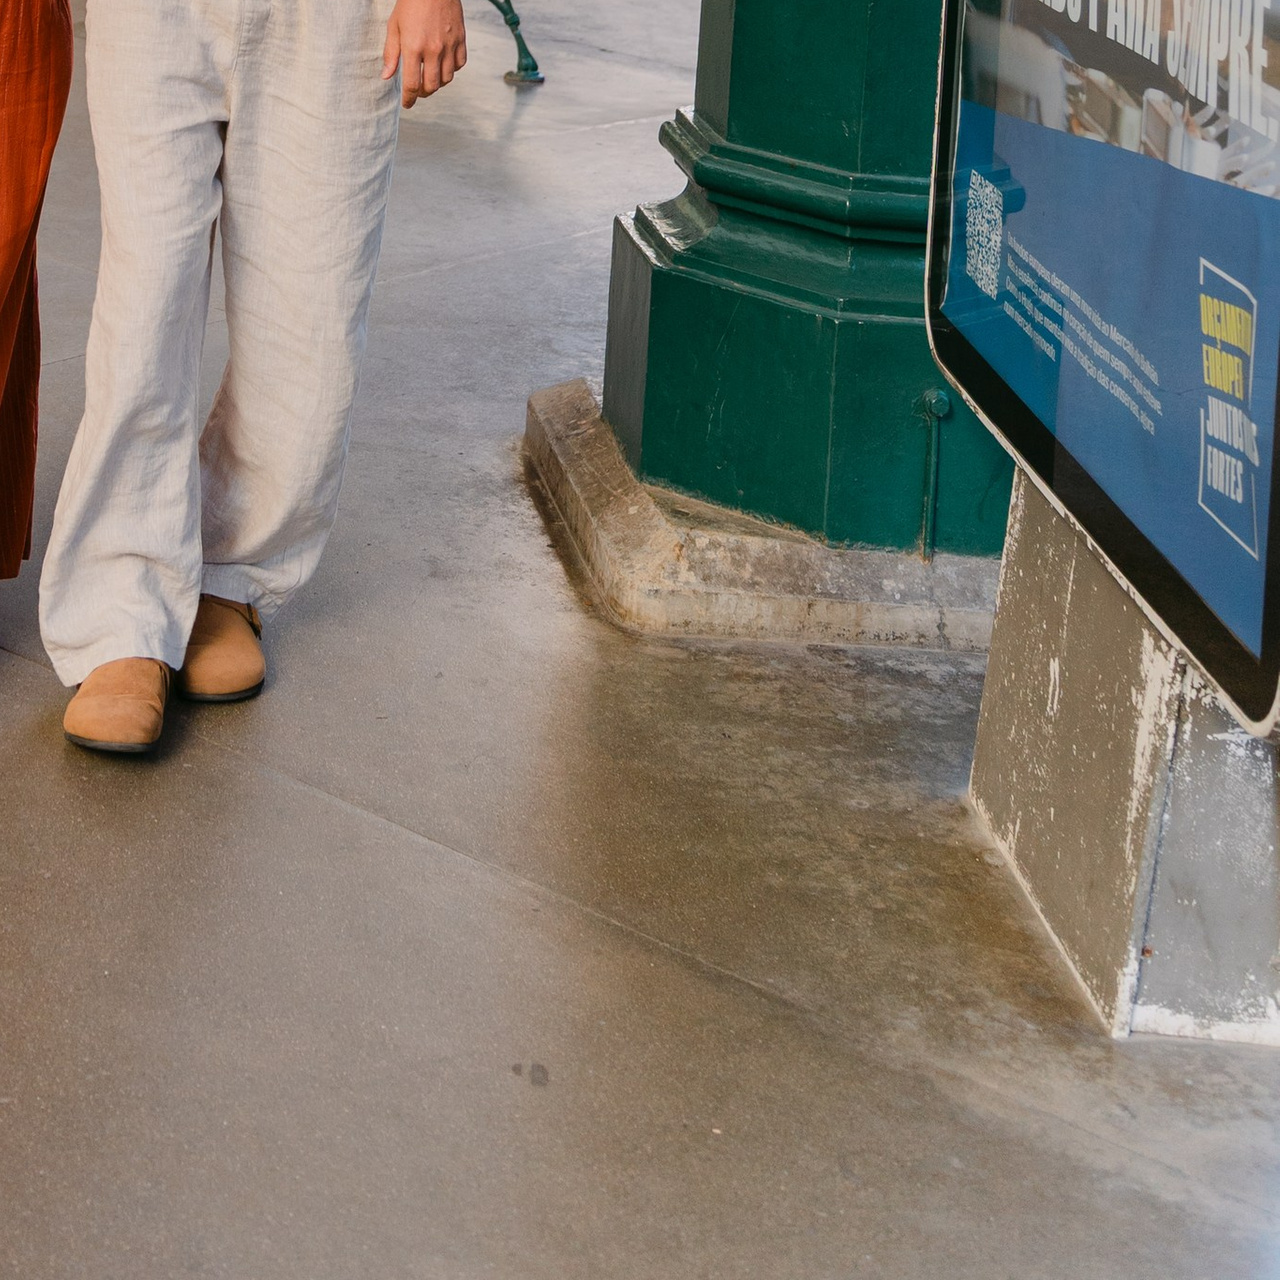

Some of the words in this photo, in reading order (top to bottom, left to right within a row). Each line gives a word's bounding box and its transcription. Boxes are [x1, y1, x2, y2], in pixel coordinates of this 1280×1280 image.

[1199, 292, 1252, 357] ORÇAME
[1202, 343, 1244, 400] EUROPE
[1207, 444, 1243, 504] FORTES
